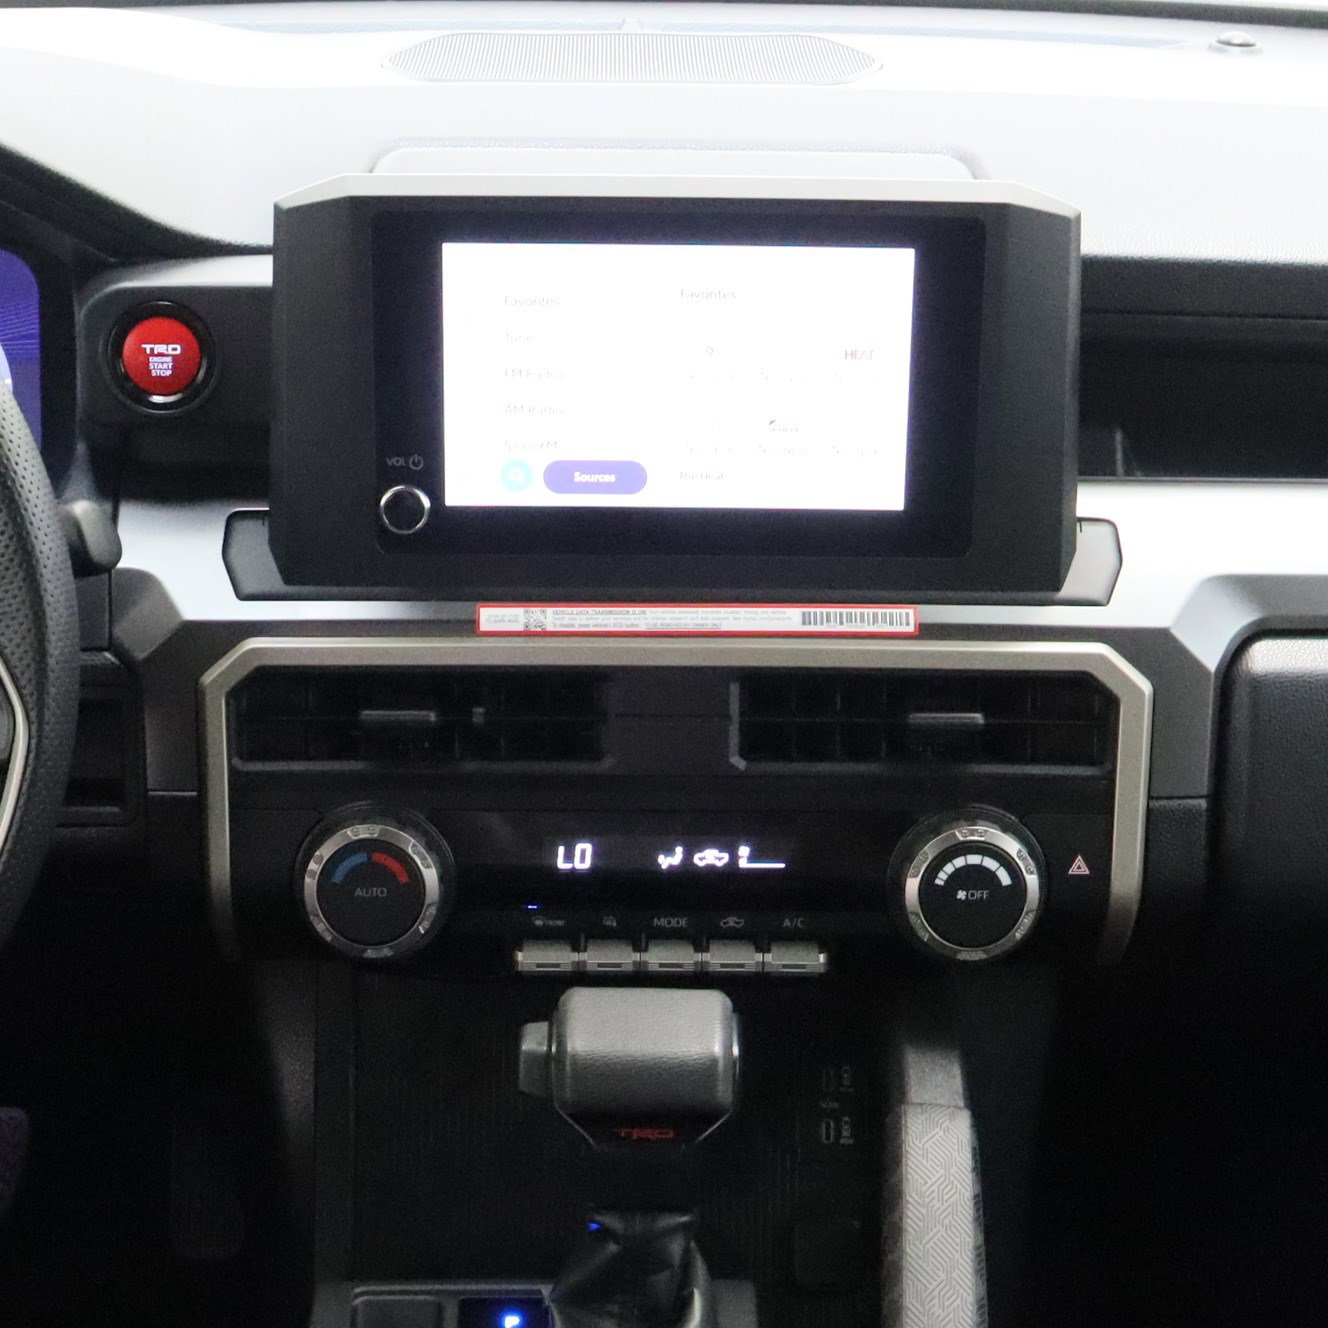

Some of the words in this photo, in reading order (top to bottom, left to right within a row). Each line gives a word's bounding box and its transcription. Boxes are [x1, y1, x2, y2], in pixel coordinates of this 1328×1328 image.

[680, 288, 736, 301] Favorites
[140, 344, 183, 355] TRD
[844, 350, 874, 360] HEAT
[385, 457, 406, 467] VOL
[573, 471, 617, 483] Sources
[354, 887, 388, 897] AUTO
[968, 890, 990, 900] OFF
[653, 917, 689, 928] MODE
[783, 917, 805, 928] A/C
[504, 1315, 521, 1328] P
